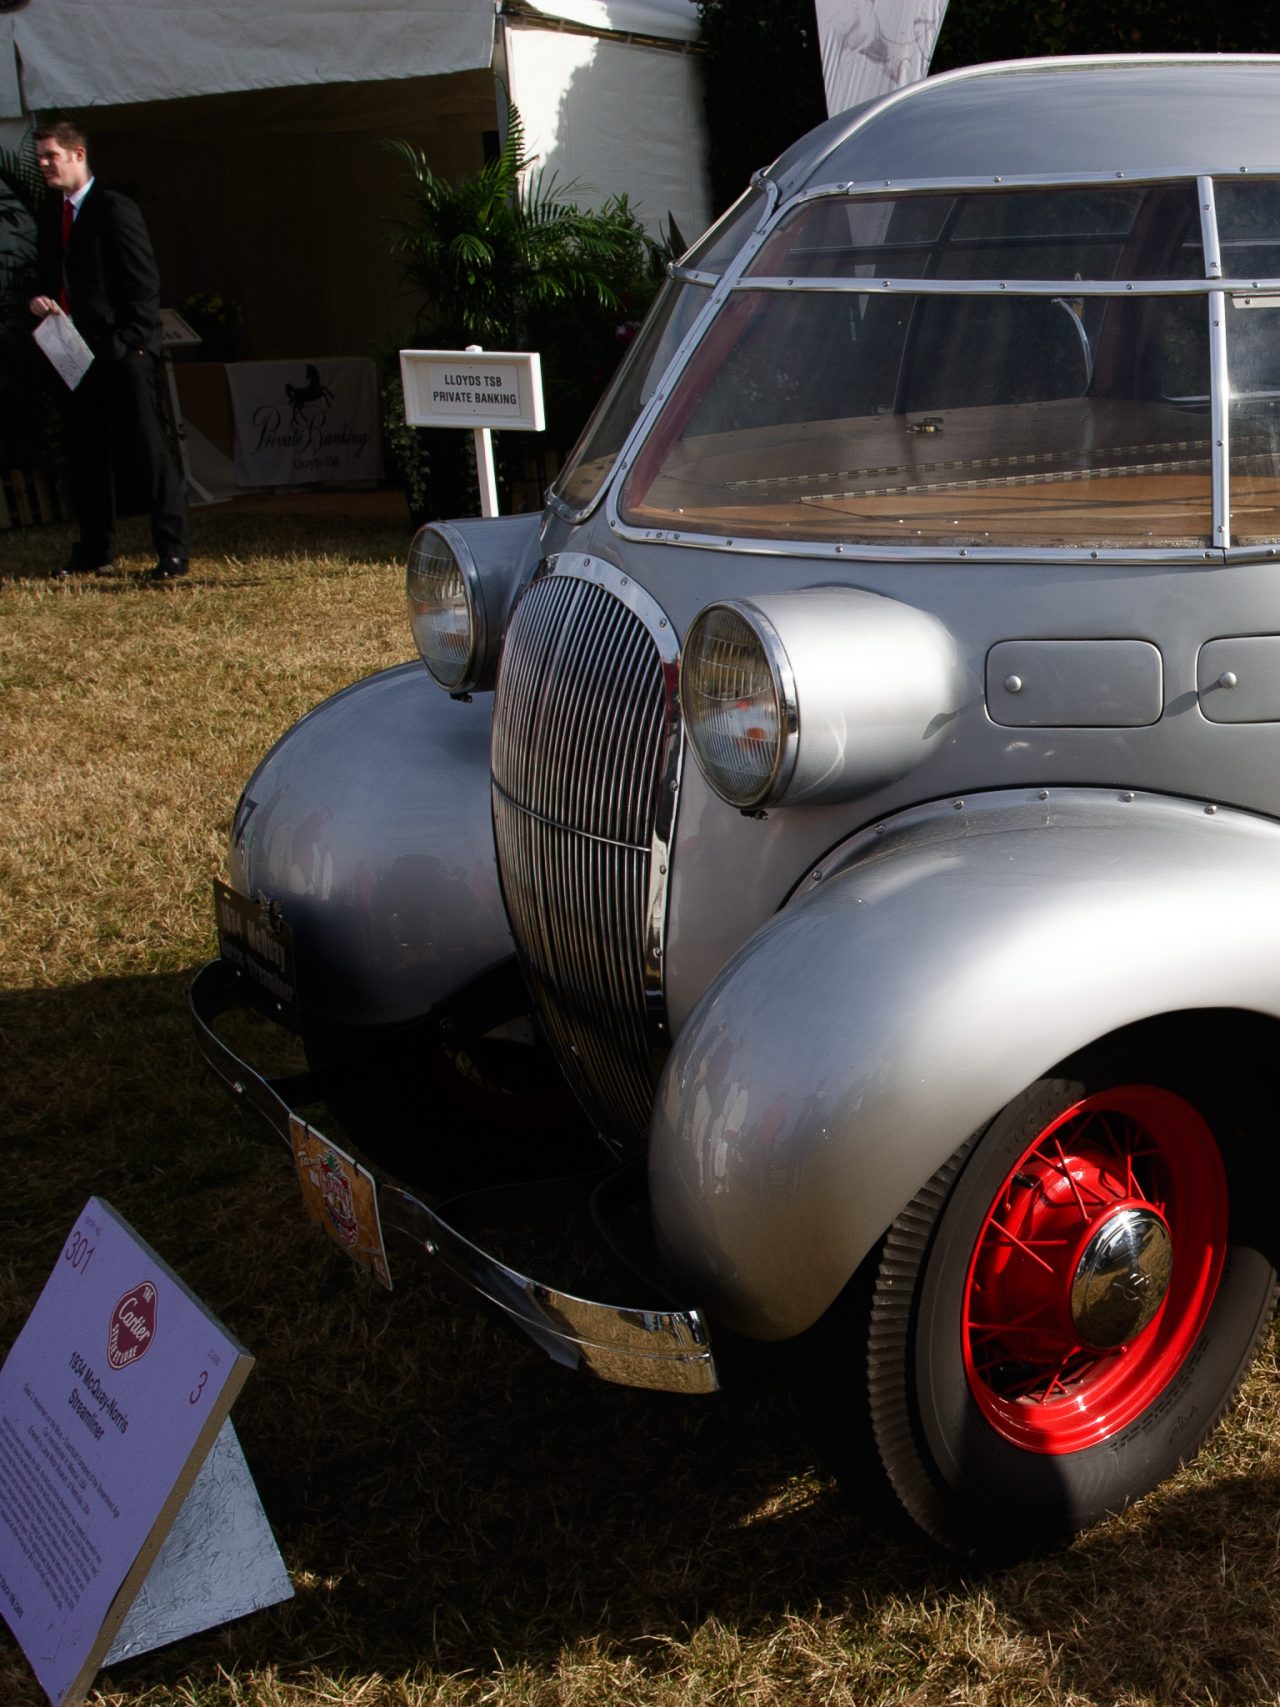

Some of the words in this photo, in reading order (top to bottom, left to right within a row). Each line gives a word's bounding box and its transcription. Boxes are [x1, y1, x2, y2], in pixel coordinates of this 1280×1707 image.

[433, 391, 472, 404] PRIVATE
[475, 393, 517, 405] BANKING
[444, 374, 481, 387] LLOYDS
[484, 376, 502, 388] TSB
[250, 405, 303, 455] Private
[295, 405, 369, 458] Banking
[65, 1230, 96, 1276] 301
[142, 1286, 154, 1303] THE
[118, 1297, 150, 1342] Cartier
[68, 1351, 87, 1377] 1934
[111, 1323, 119, 1356] STYLE
[120, 1345, 138, 1364] LUXE
[82, 1367, 129, 1434] McQuay-Norris
[189, 1370, 209, 1405] 3
[68, 1388, 106, 1441] Streamliner
